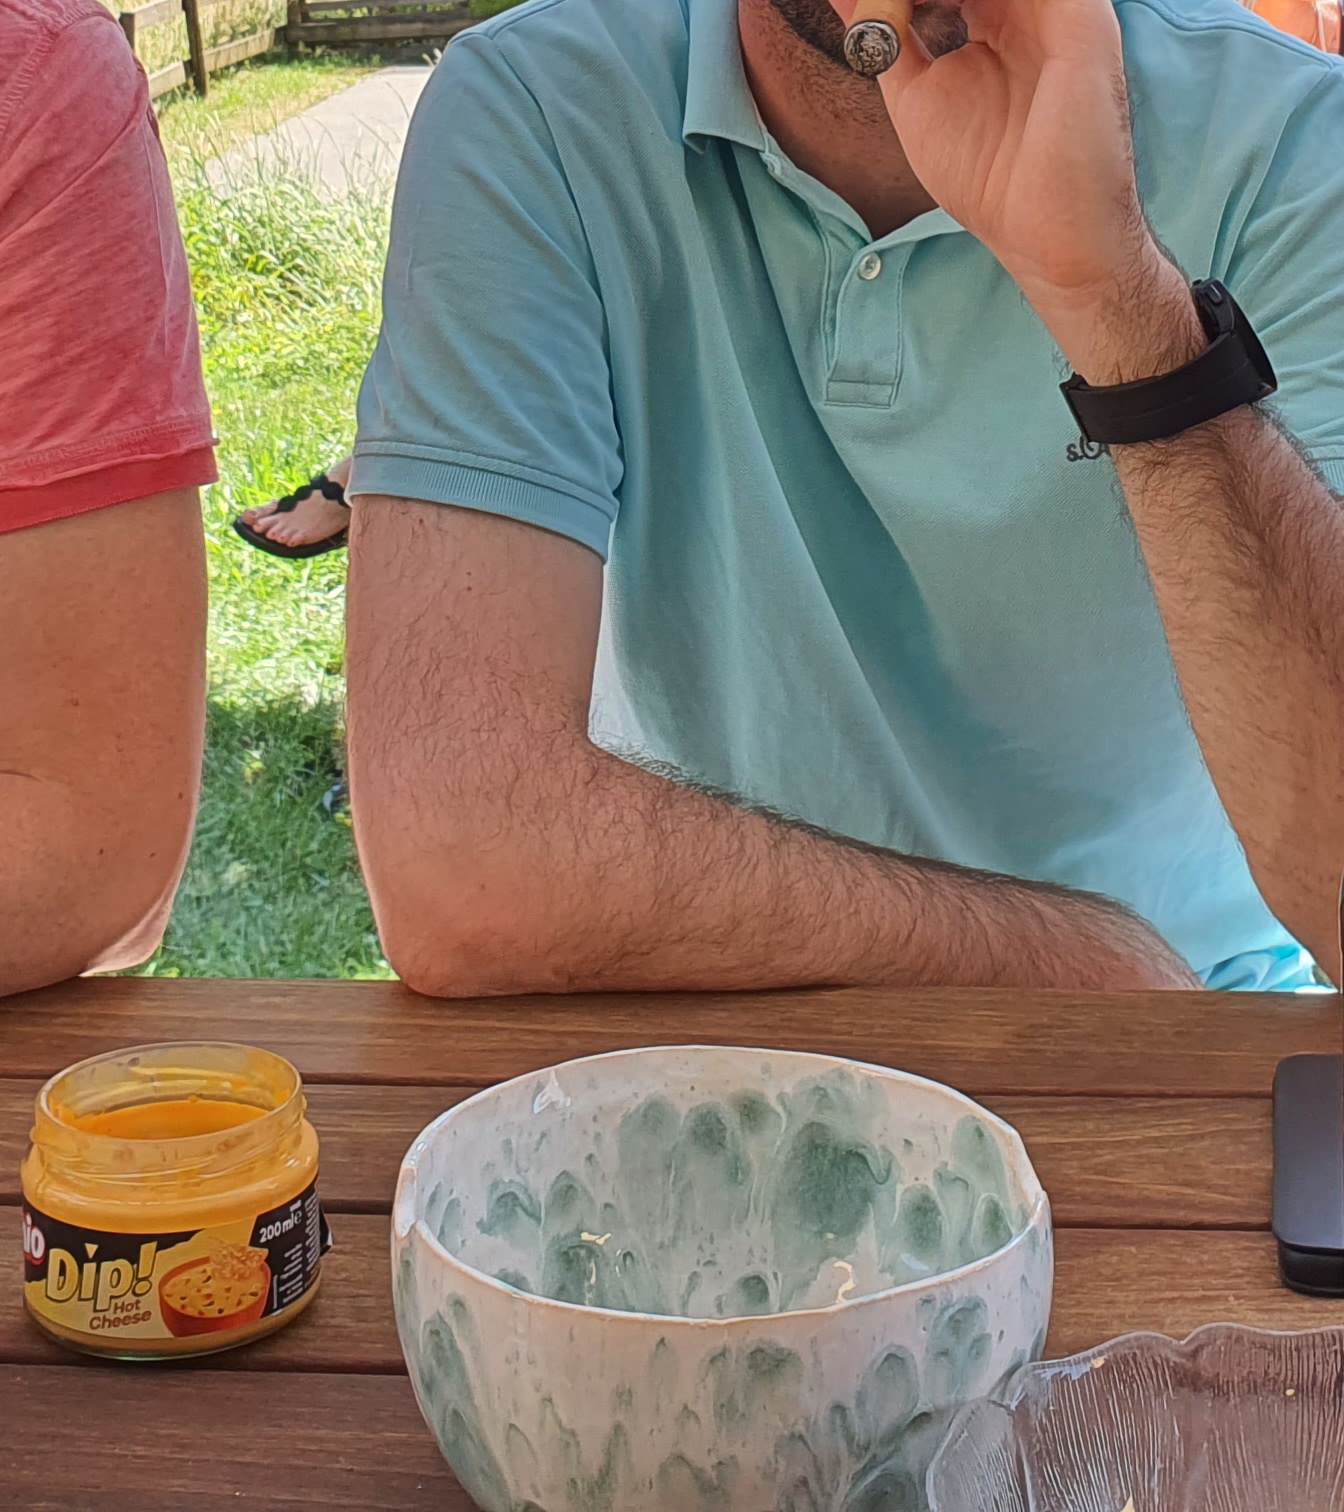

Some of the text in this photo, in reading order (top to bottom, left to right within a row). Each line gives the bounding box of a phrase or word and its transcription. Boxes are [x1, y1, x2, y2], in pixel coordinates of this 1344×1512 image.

[259, 1220, 282, 1244] 200
[45, 1240, 159, 1313] Dip!
[113, 1299, 142, 1315] Hot
[89, 1310, 152, 1331] Cheese
